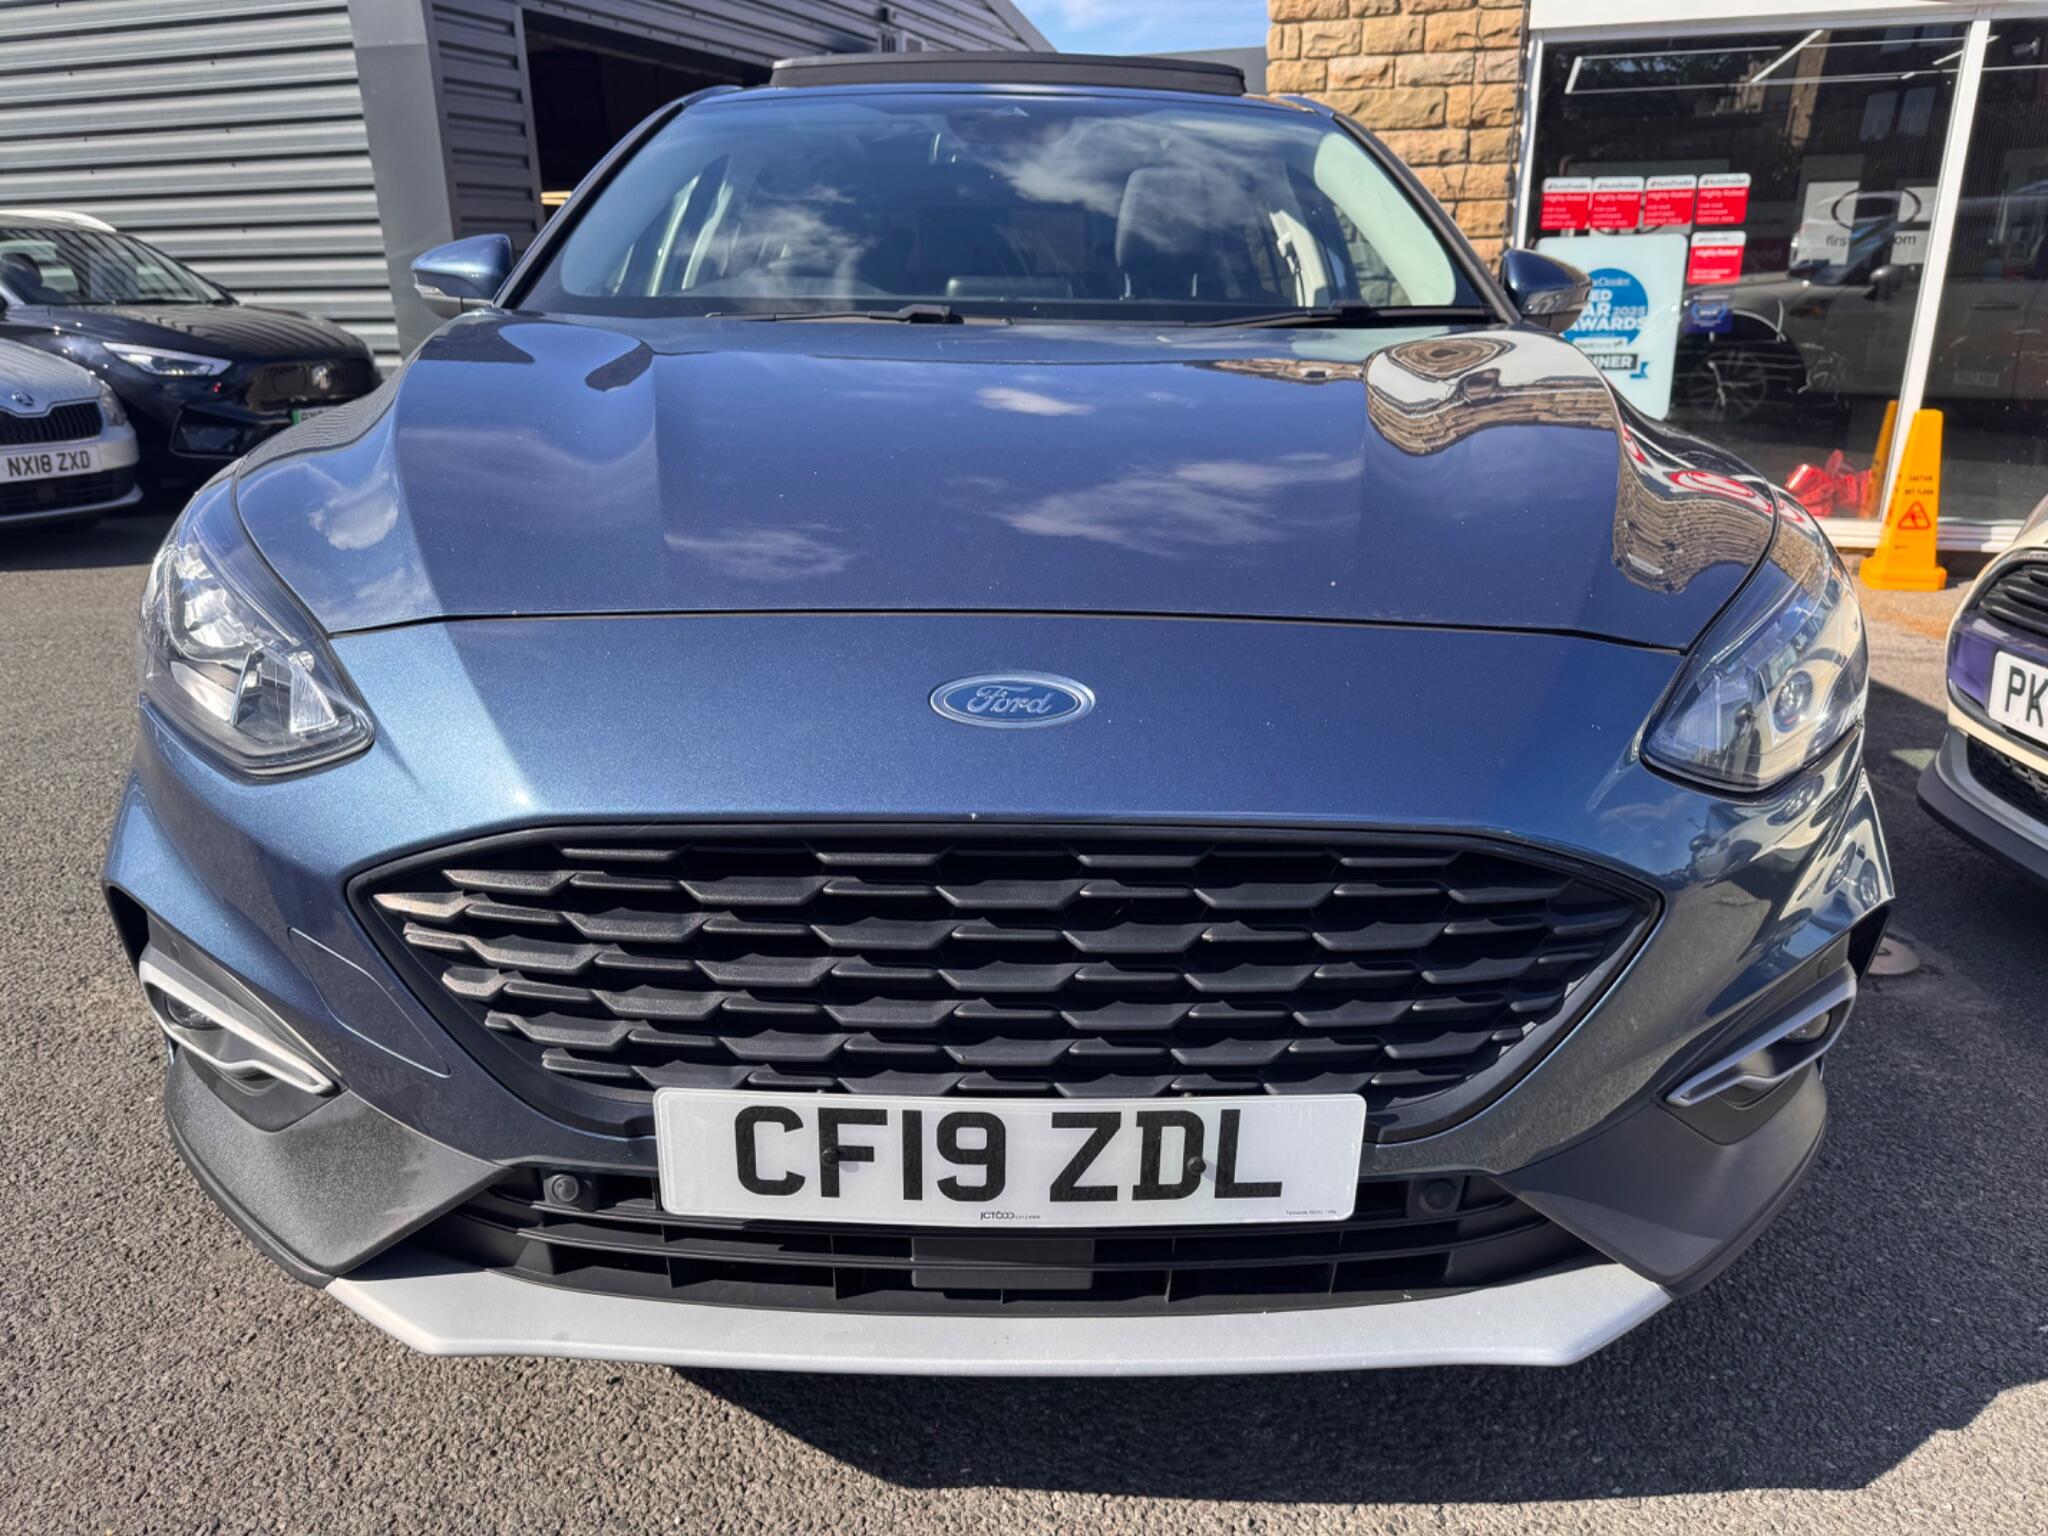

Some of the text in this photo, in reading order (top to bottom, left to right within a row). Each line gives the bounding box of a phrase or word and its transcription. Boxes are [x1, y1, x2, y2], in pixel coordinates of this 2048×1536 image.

[7, 450, 91, 477] NX18 ZXD
[967, 684, 1055, 714] Ford
[735, 1105, 1283, 1202] CF19 ZDL
